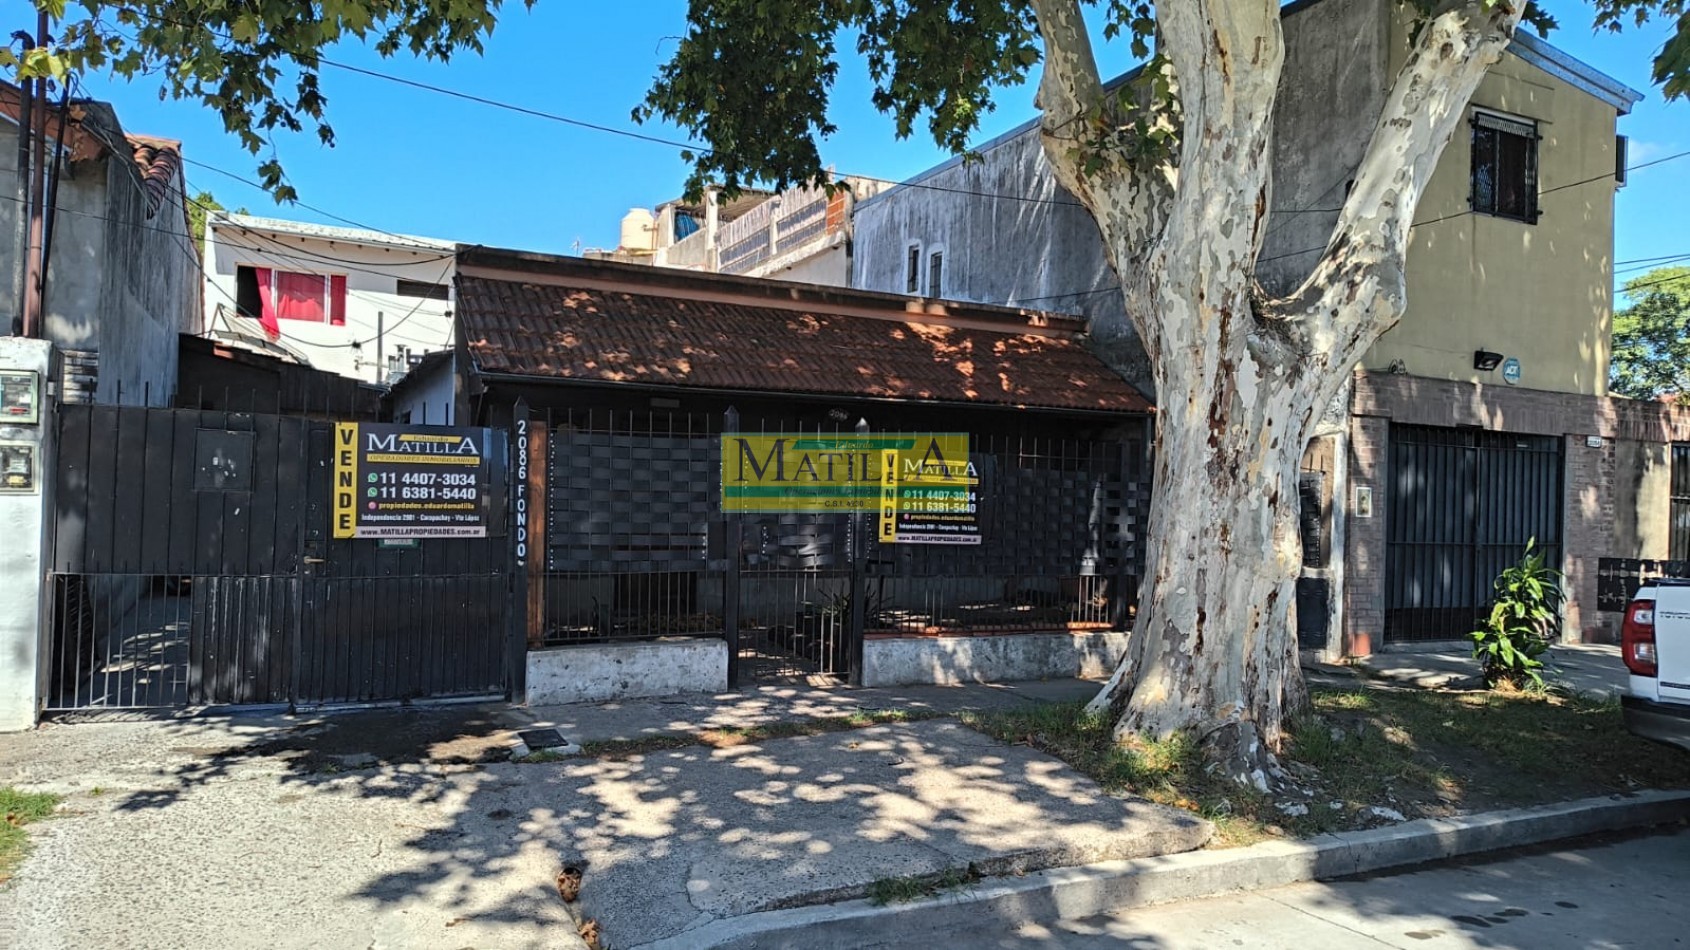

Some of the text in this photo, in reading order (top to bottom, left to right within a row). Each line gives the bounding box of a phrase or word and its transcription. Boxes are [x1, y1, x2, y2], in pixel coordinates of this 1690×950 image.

[366, 433, 479, 454] MATILLA
[517, 420, 527, 479] 2086
[339, 429, 354, 529] VENDE
[380, 472, 476, 485] 11 4407-3034
[380, 487, 476, 499] 11 6381-5440
[884, 454, 895, 537] VENDE
[912, 490, 976, 502] 11 4407-3034
[913, 502, 976, 513] 11 6381-5440
